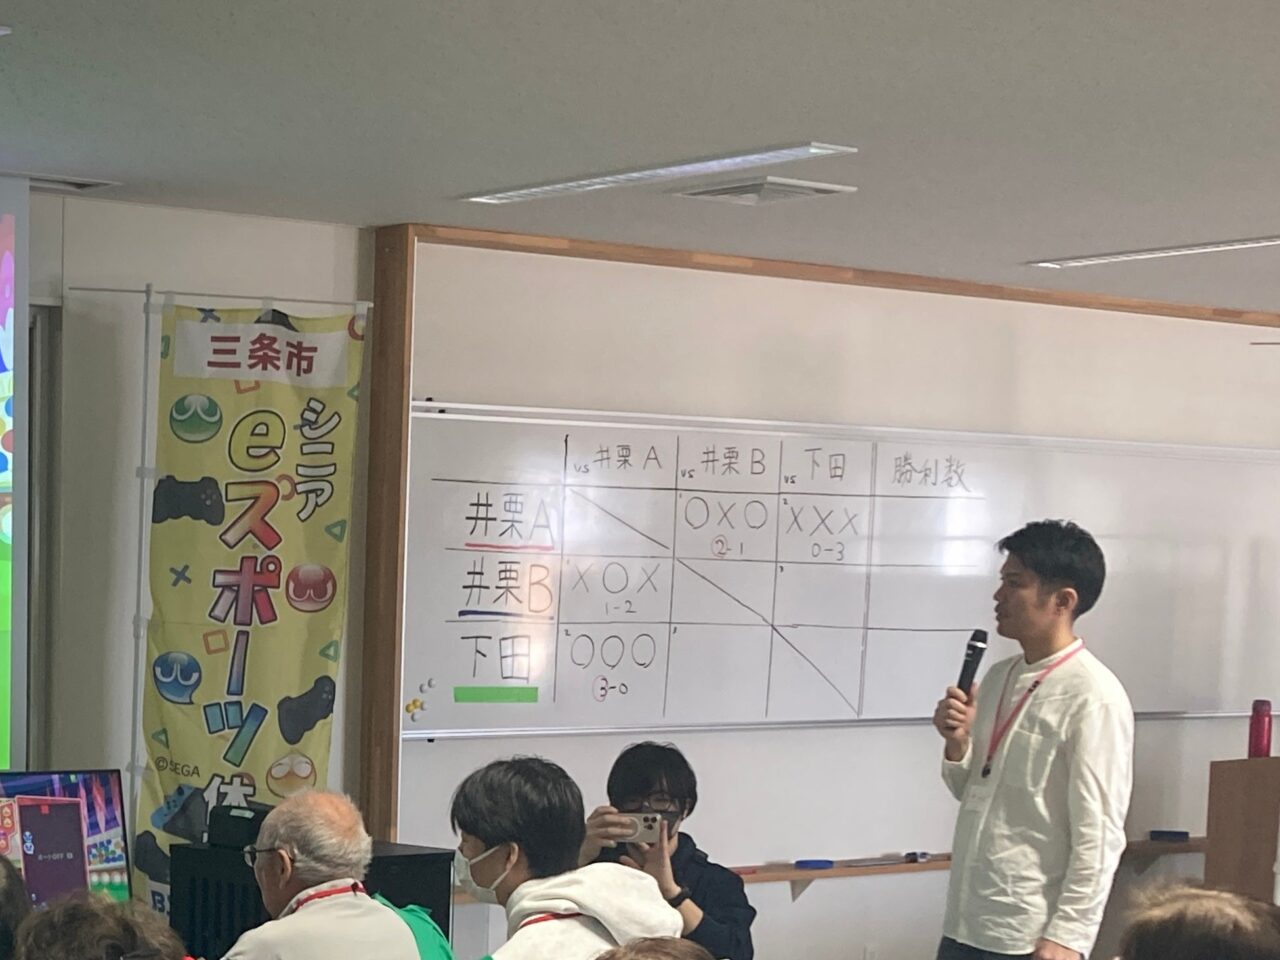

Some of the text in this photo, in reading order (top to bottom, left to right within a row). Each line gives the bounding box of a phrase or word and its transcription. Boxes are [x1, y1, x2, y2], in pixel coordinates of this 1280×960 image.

[207, 333, 318, 377] 三条市
[295, 397, 341, 523] シニア
[804, 448, 846, 482] 下田
[892, 451, 971, 492] 勝利数
[465, 492, 555, 545] 井栗A
[461, 556, 553, 614] 井栗B
[461, 634, 531, 684] 下田
